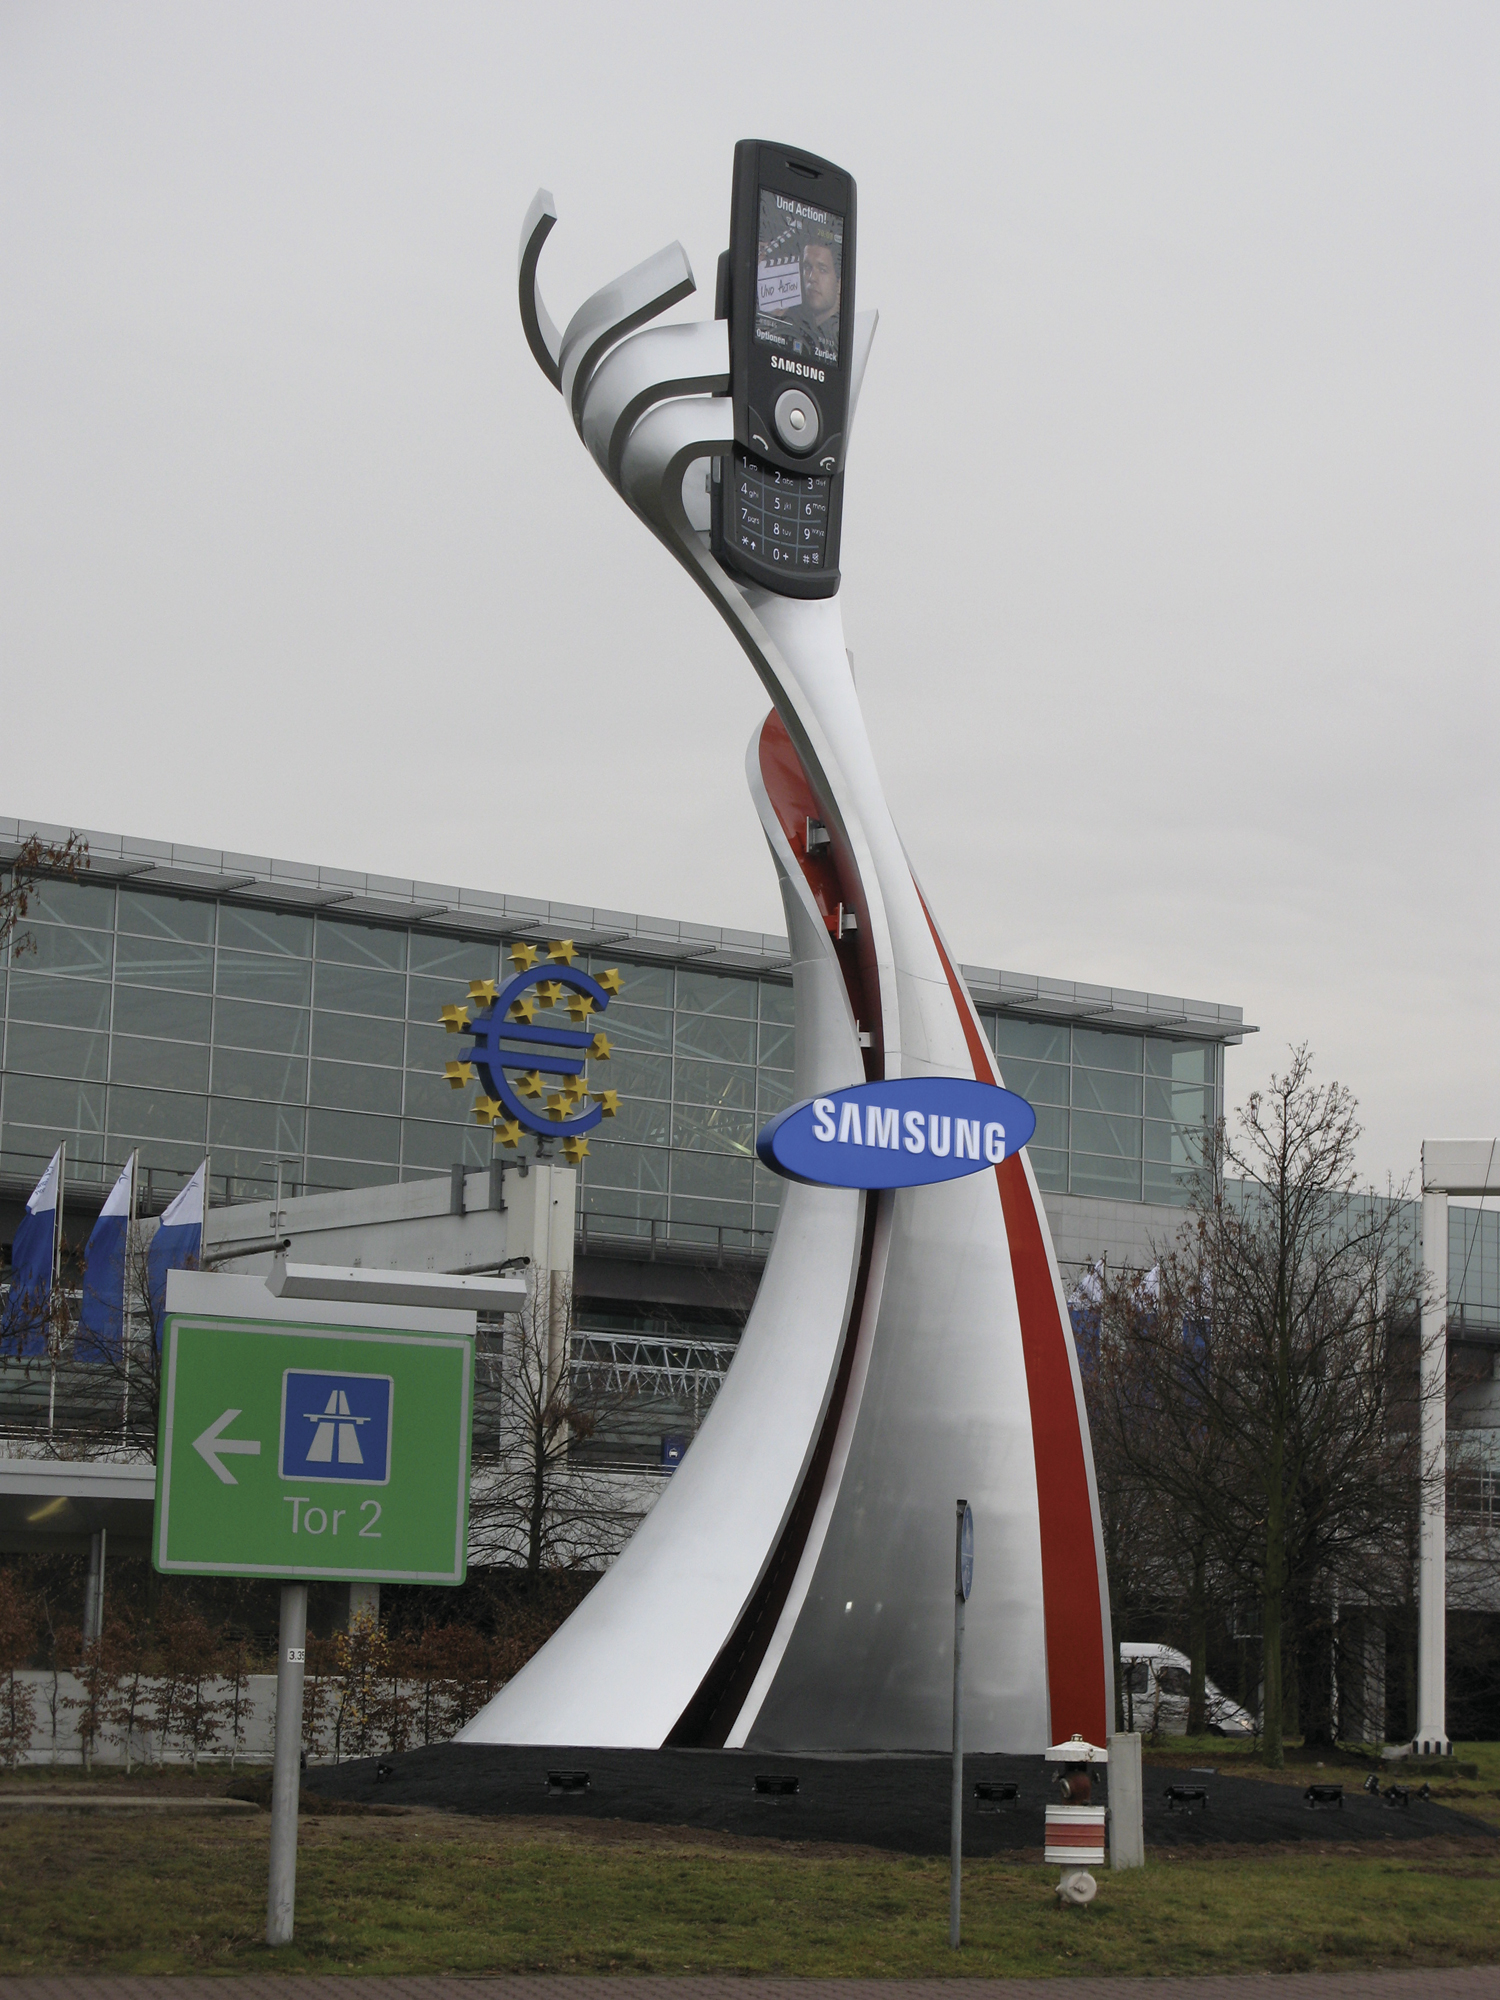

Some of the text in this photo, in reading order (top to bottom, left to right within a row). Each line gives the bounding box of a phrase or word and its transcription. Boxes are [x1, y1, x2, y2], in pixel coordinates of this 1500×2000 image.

[776, 195, 827, 225] Und Action!
[756, 328, 786, 345] Optionen
[814, 347, 837, 361] Zurück
[770, 355, 825, 382] SAMSUNG
[742, 456, 747, 468] 1
[774, 471, 781, 484] 2
[807, 477, 814, 490] 3
[740, 482, 748, 494] 4
[774, 498, 780, 510] 5
[805, 503, 812, 515] 6
[741, 508, 748, 519] 7
[773, 523, 780, 535] 8
[804, 528, 811, 540] 9
[773, 548, 780, 561] 0
[812, 1097, 1006, 1164] SAMSUNG
[283, 1496, 382, 1537] Tor 2
